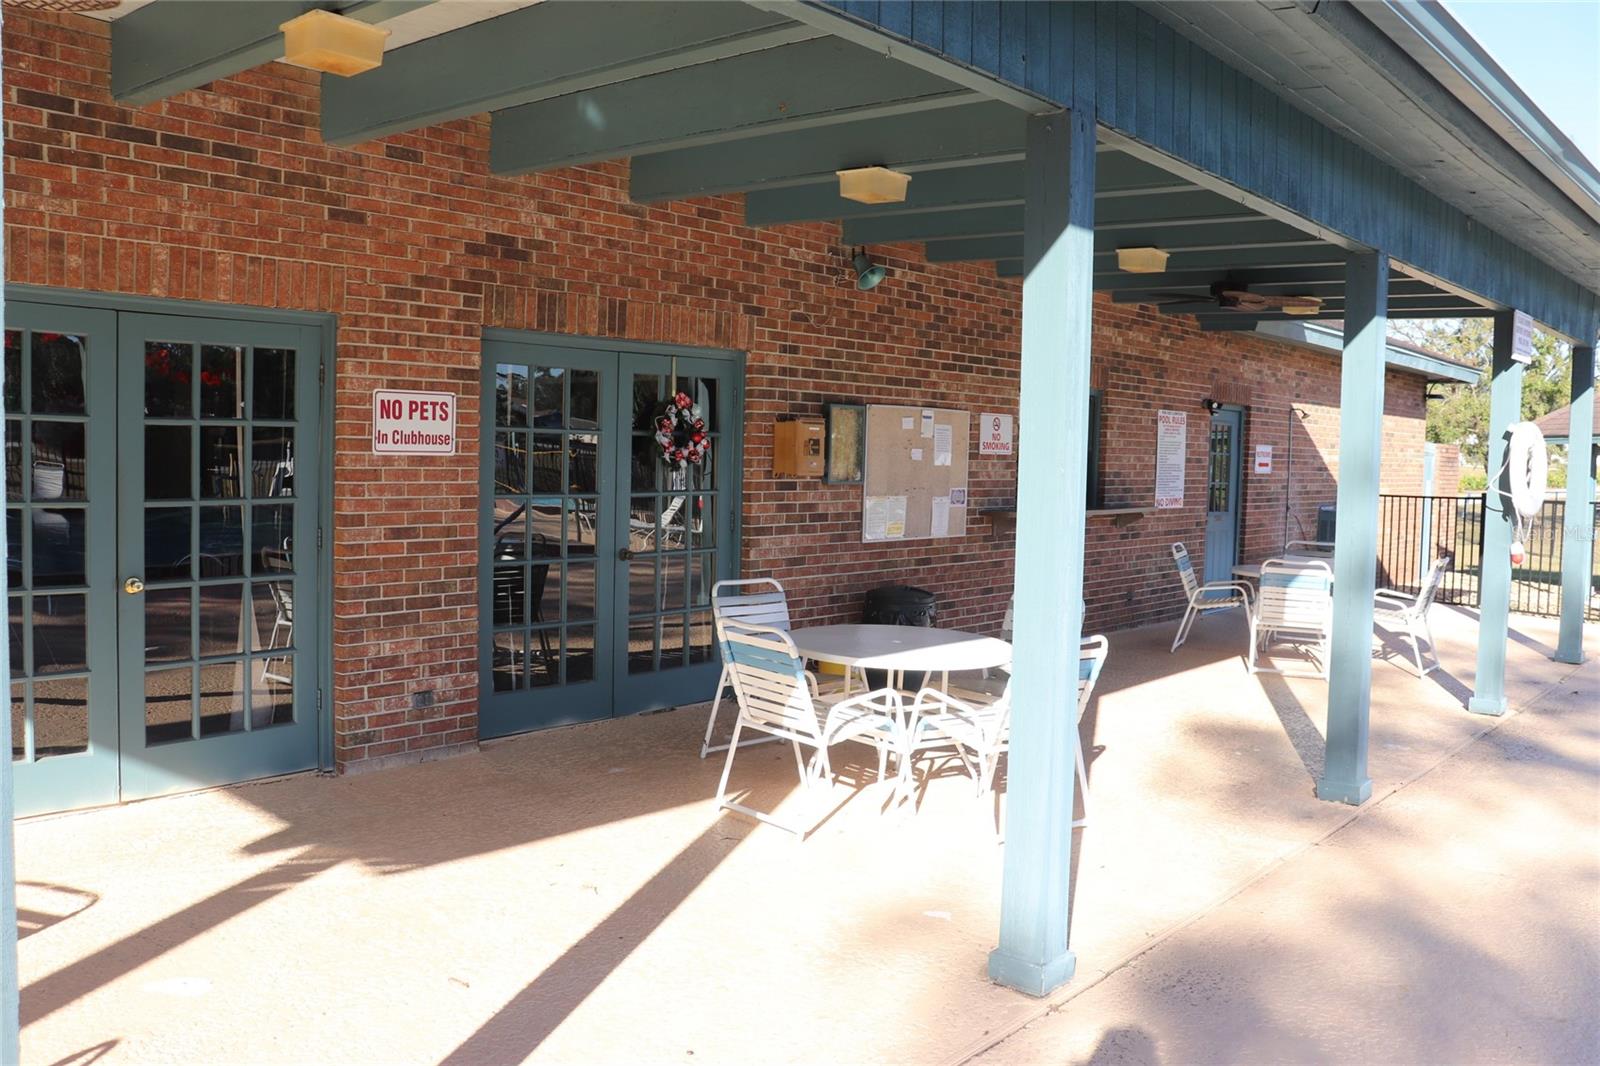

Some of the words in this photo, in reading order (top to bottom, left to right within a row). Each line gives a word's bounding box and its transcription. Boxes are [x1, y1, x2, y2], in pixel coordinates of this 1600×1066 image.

[380, 399, 402, 420] NO
[408, 400, 449, 422] PETS
[1159, 415, 1171, 424] POOL
[1172, 416, 1185, 425] RULES
[377, 429, 388, 444] In
[392, 430, 450, 445] Clubhouse
[991, 433, 1001, 441] NO
[982, 441, 1010, 451] SMOKING
